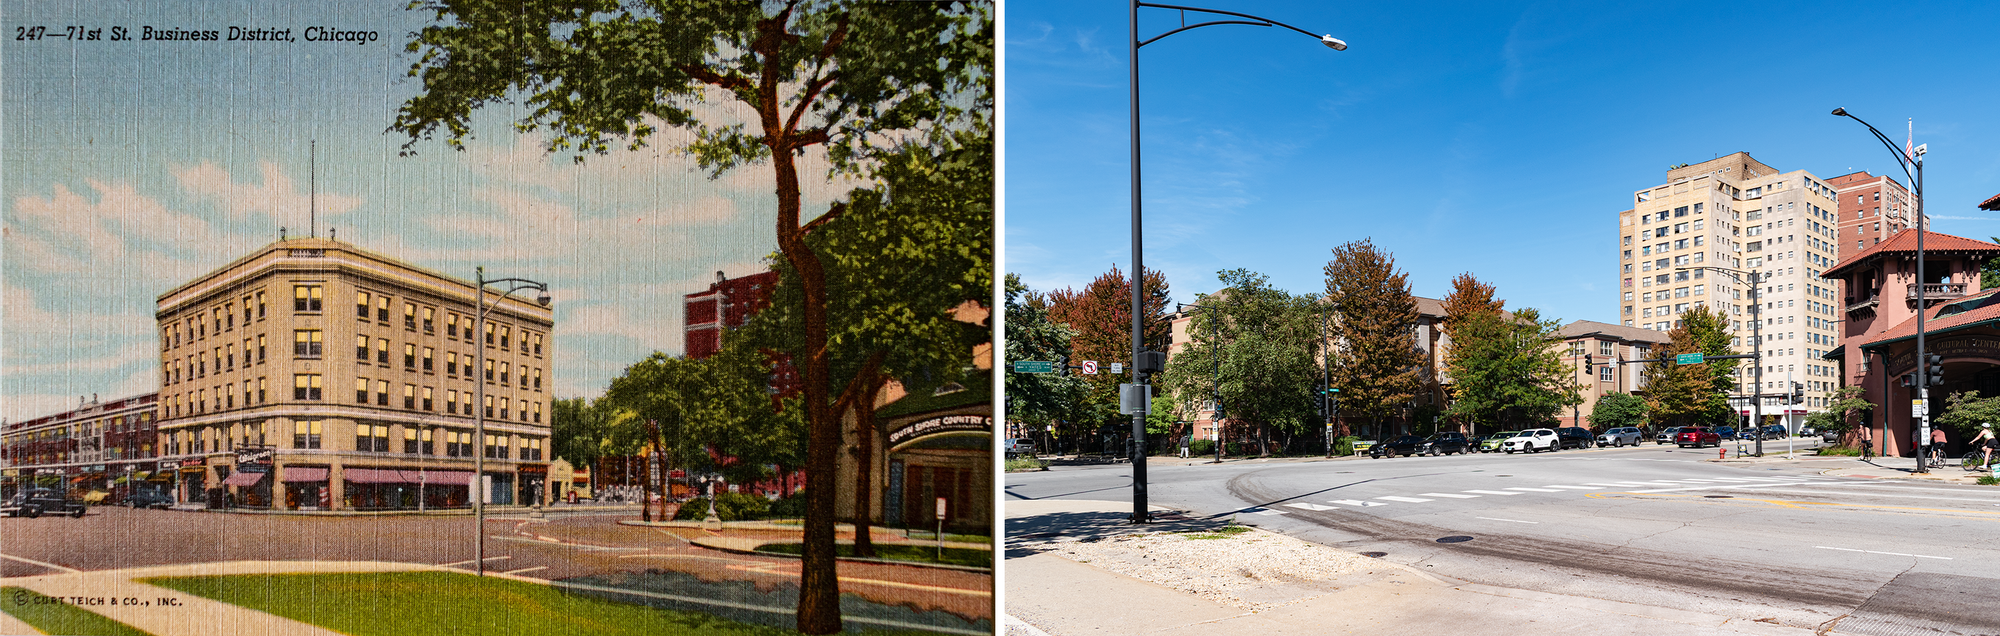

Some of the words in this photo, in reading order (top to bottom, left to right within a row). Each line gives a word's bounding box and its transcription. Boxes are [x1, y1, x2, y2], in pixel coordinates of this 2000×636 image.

[1936, 339, 1969, 350] CULTURAL
[889, 425, 914, 442] SOUTH
[914, 418, 941, 432] SHORE
[942, 415, 983, 425] COUNTRY
